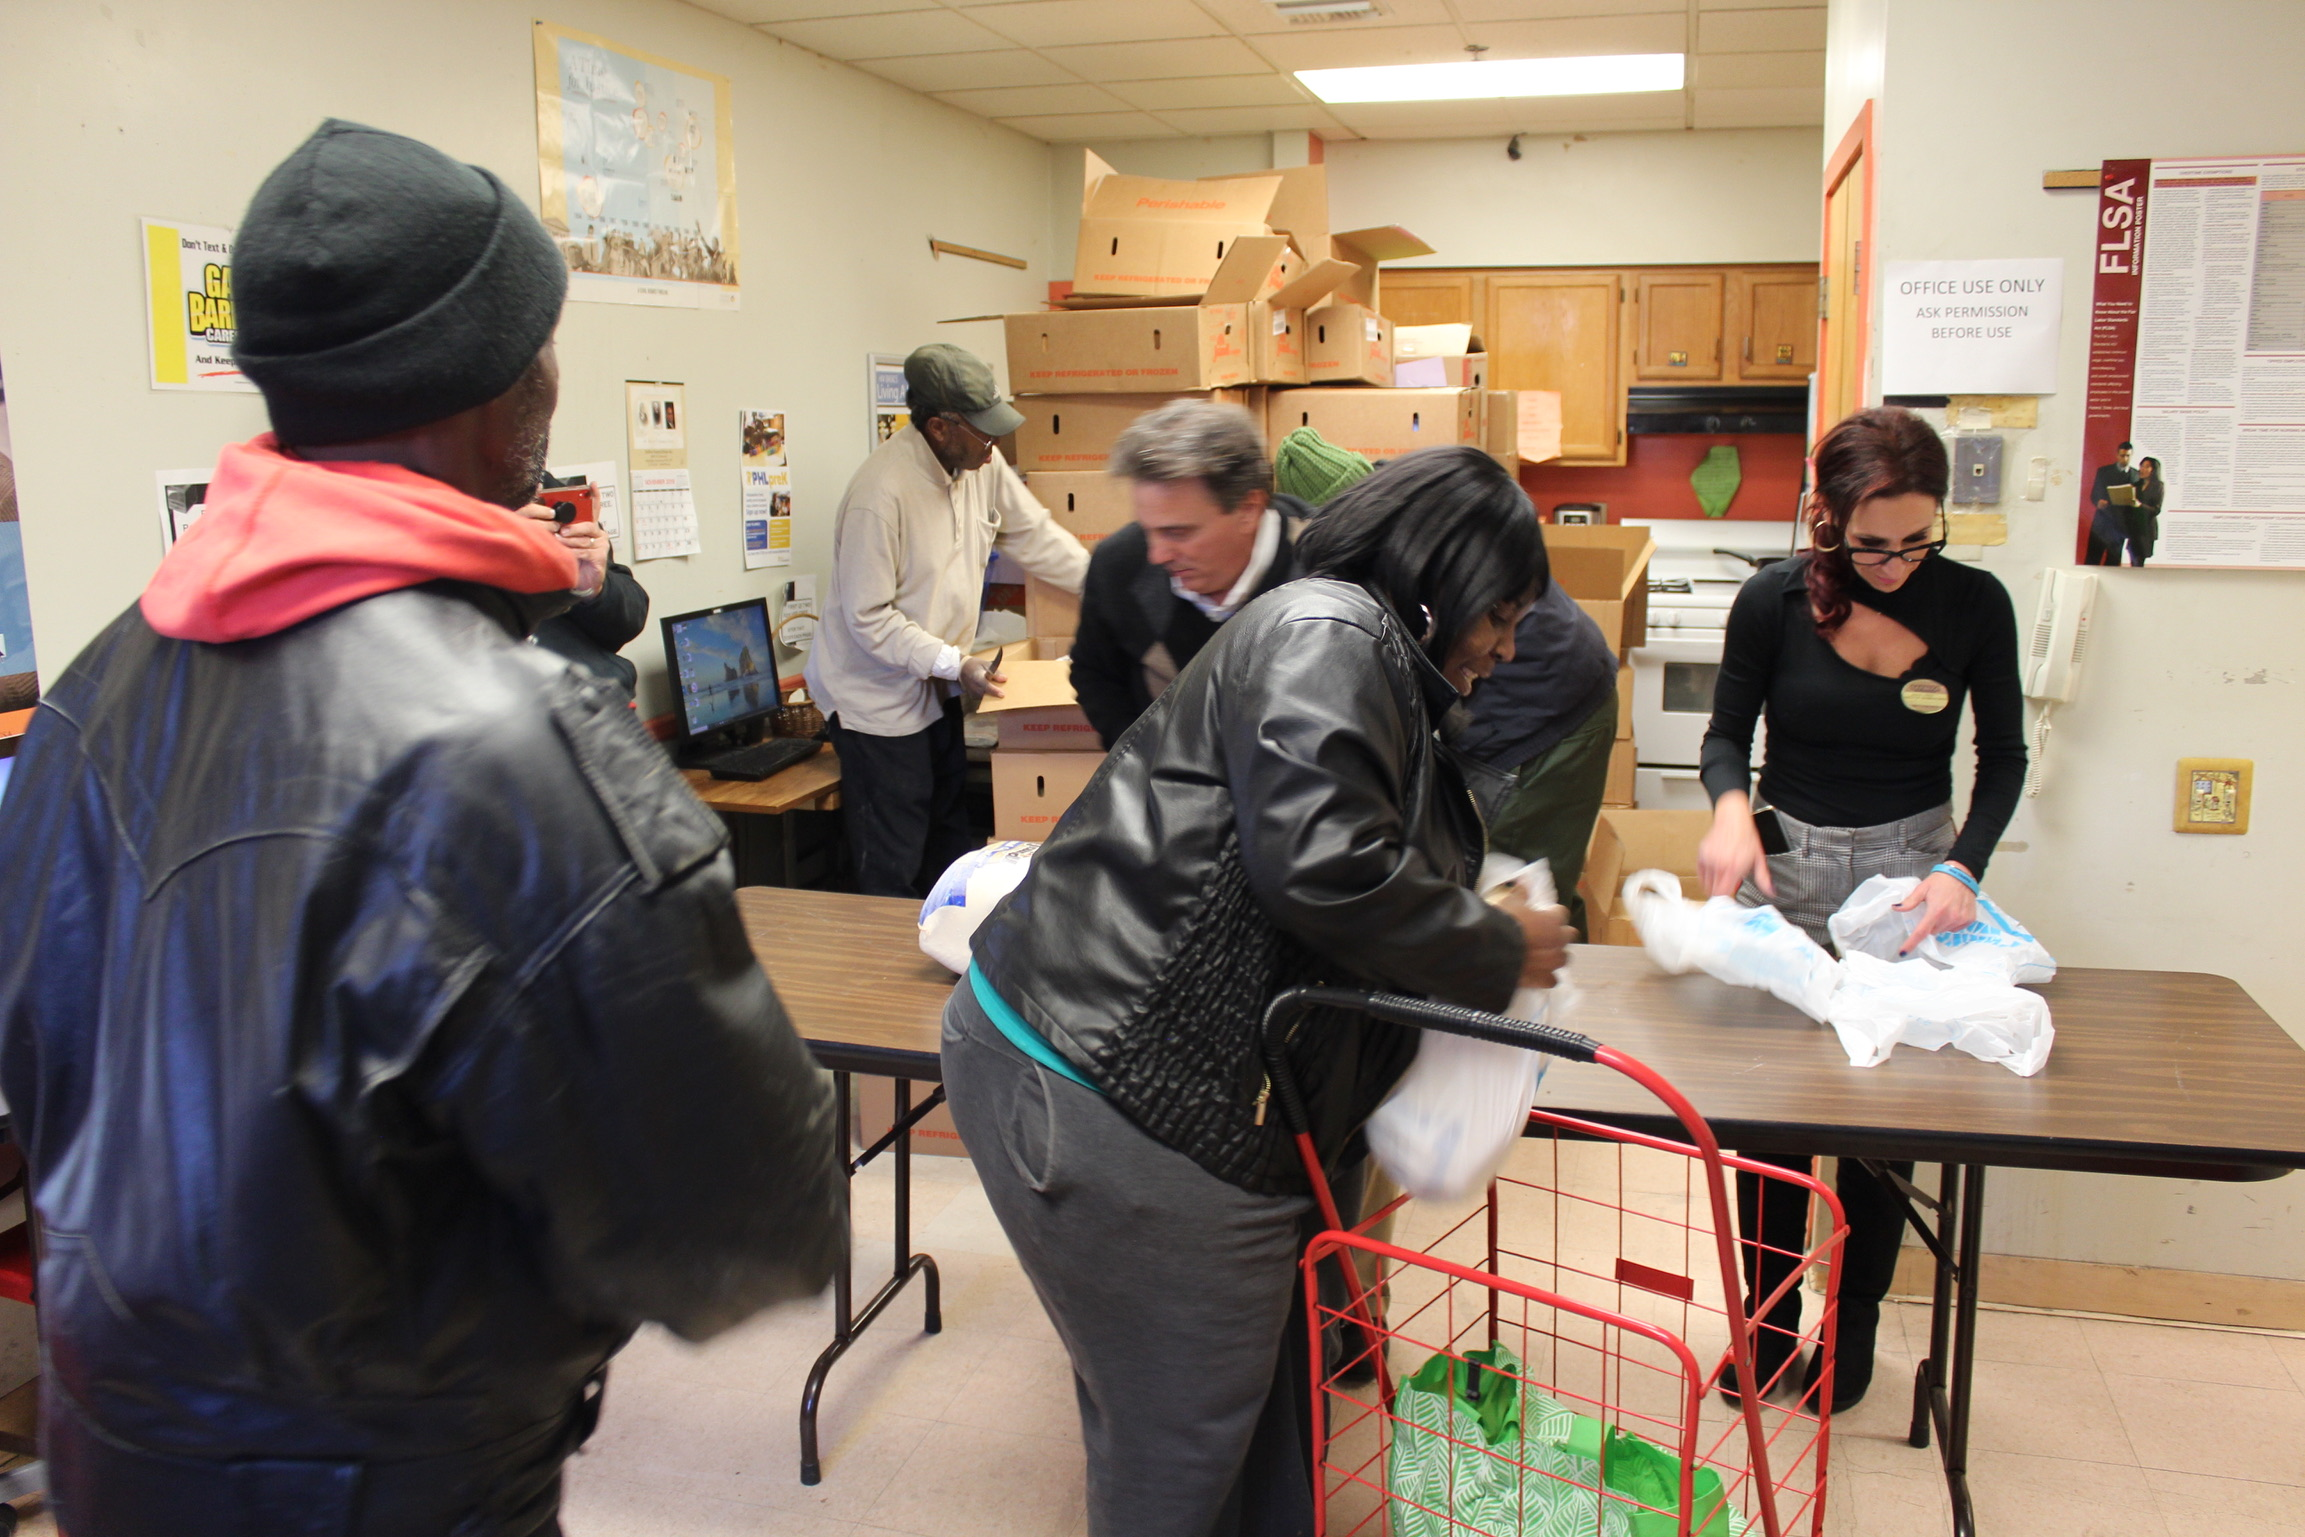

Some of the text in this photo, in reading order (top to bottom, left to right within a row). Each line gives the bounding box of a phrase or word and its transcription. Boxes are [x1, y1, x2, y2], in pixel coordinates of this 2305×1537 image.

[1135, 197, 1227, 210] Perishable
[2099, 177, 2136, 274] FLSA
[2131, 196, 2144, 276] INFORMATION POSTER
[182, 238, 202, 250] Don't
[204, 241, 220, 253] Text
[222, 243, 227, 253] &
[1118, 275, 1182, 284] REFRIGERATED
[1184, 276, 1197, 284] OR
[1900, 278, 2045, 295] OFFICE USE ONLY
[1916, 305, 2029, 318] ASK PERMISSION
[1931, 326, 2012, 339] BEFORE USE
[196, 355, 212, 364] And
[1055, 370, 1123, 378] REFRIGERATED
[1141, 368, 1179, 376] FROZEN
[877, 383, 899, 403] Living
[1038, 454, 1062, 462] KEEP
[752, 471, 788, 488] PHLpreK
[1023, 724, 1050, 732] KEEP
